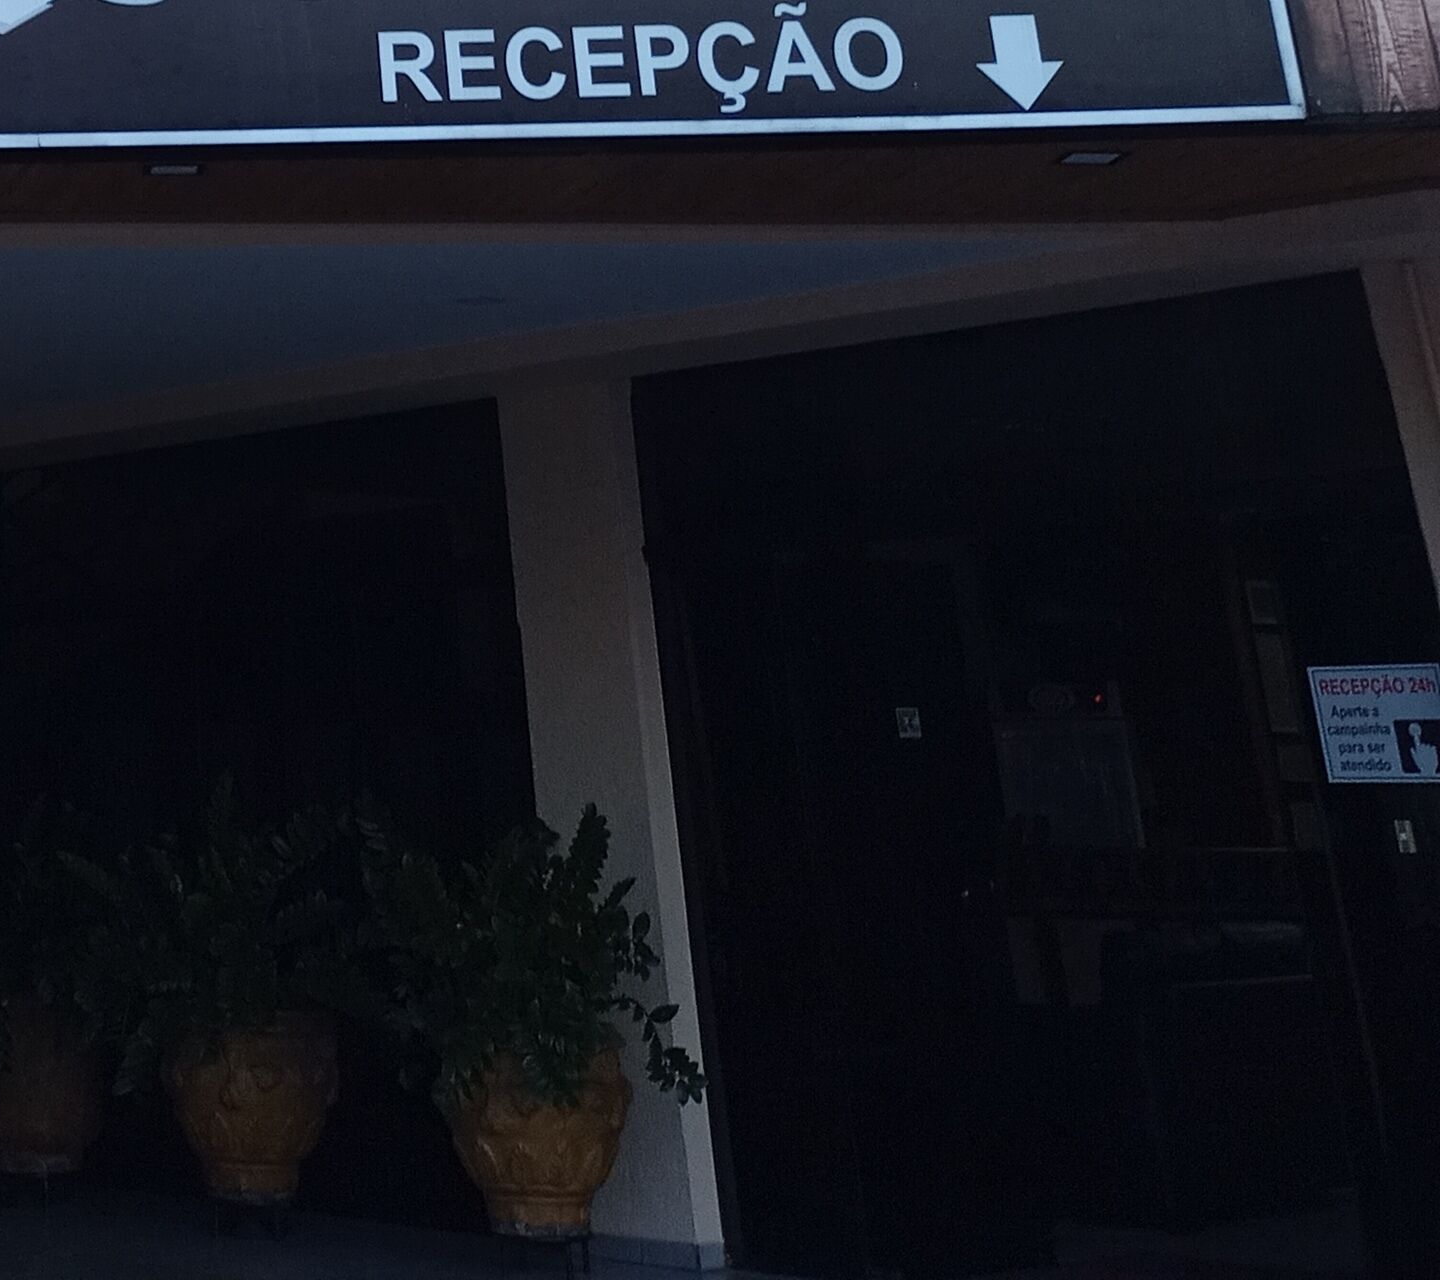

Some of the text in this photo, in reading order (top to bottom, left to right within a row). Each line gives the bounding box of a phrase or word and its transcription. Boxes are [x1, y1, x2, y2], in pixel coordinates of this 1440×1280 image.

[376, 2, 904, 113] RECEPÇÃO
[1319, 675, 1436, 698] RECEPÇÃO 24h
[1331, 705, 1368, 720] Aperte
[1327, 723, 1390, 736] campainha
[1338, 742, 1387, 756] para ser
[1340, 758, 1392, 772] atendido
